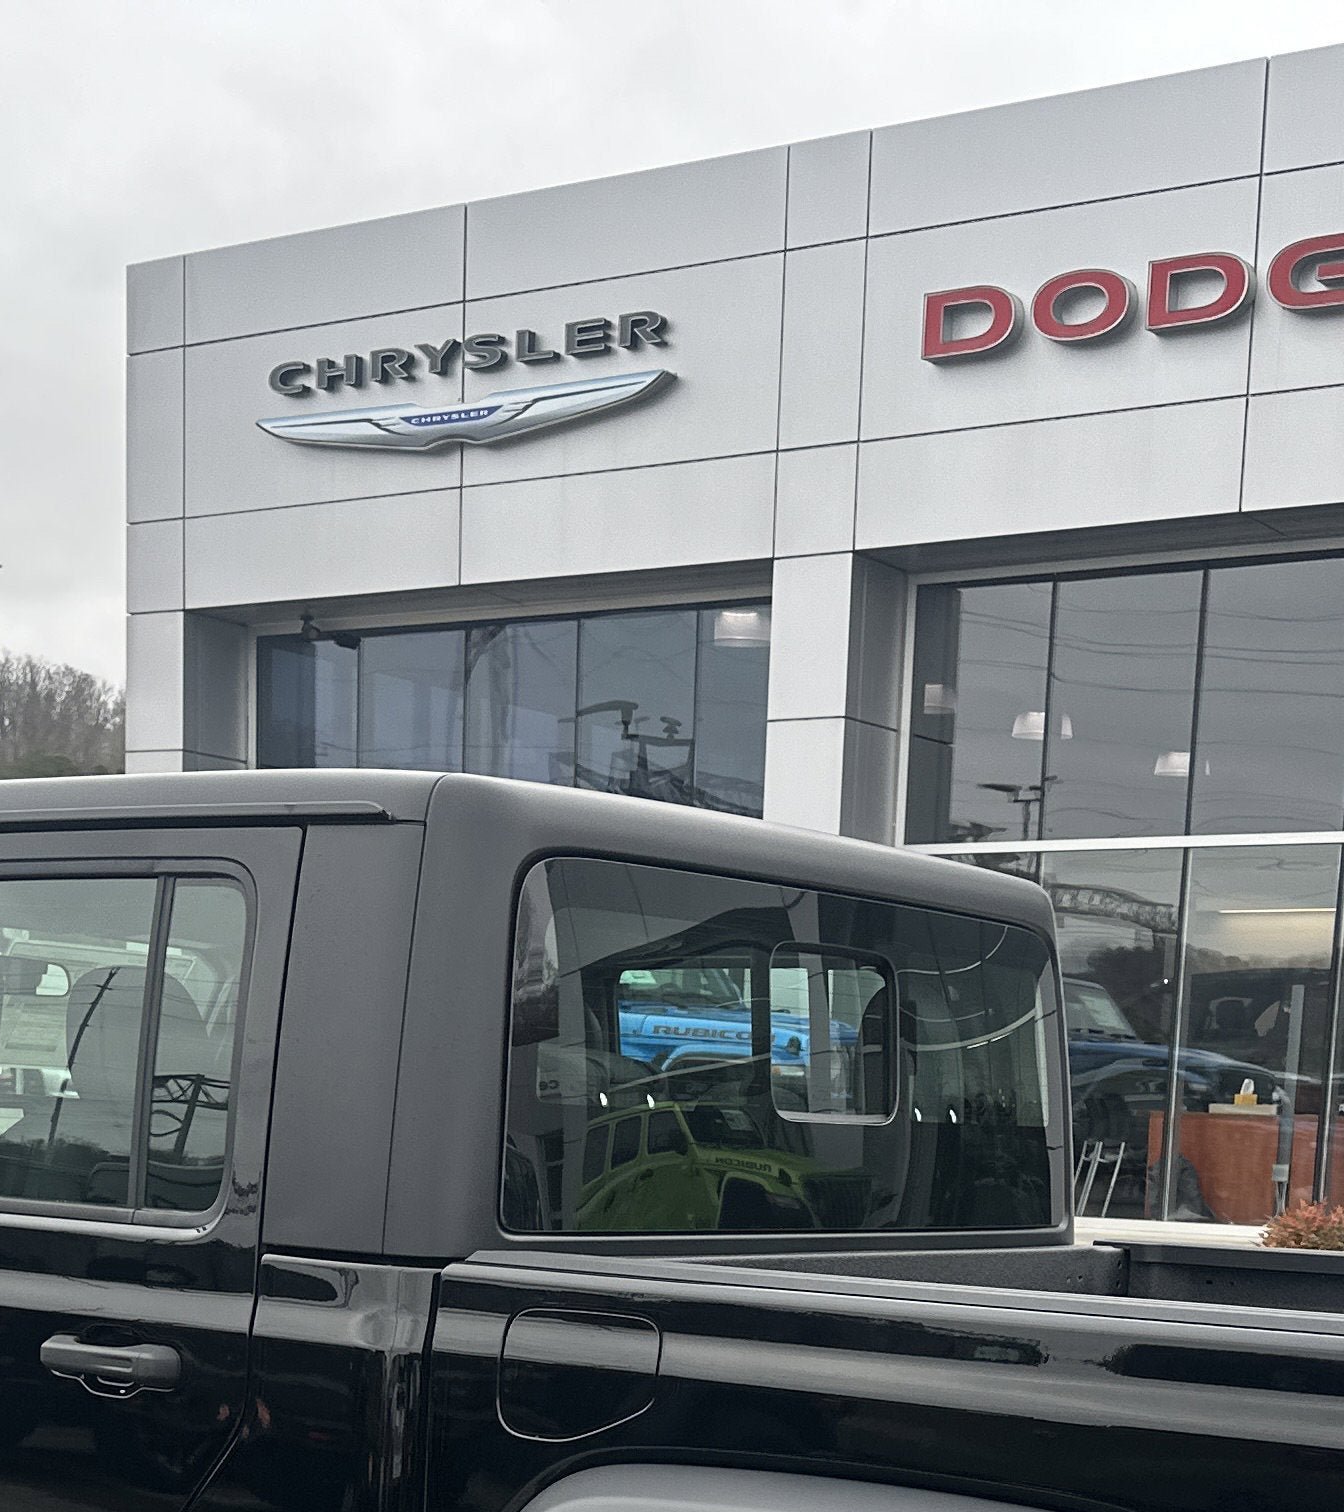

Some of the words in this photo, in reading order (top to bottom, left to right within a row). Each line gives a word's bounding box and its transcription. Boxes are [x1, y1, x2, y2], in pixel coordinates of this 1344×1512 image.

[267, 310, 668, 396] CHRYSLER
[410, 408, 490, 426] CHRYSLER
[652, 1024, 776, 1044] RUBICO
